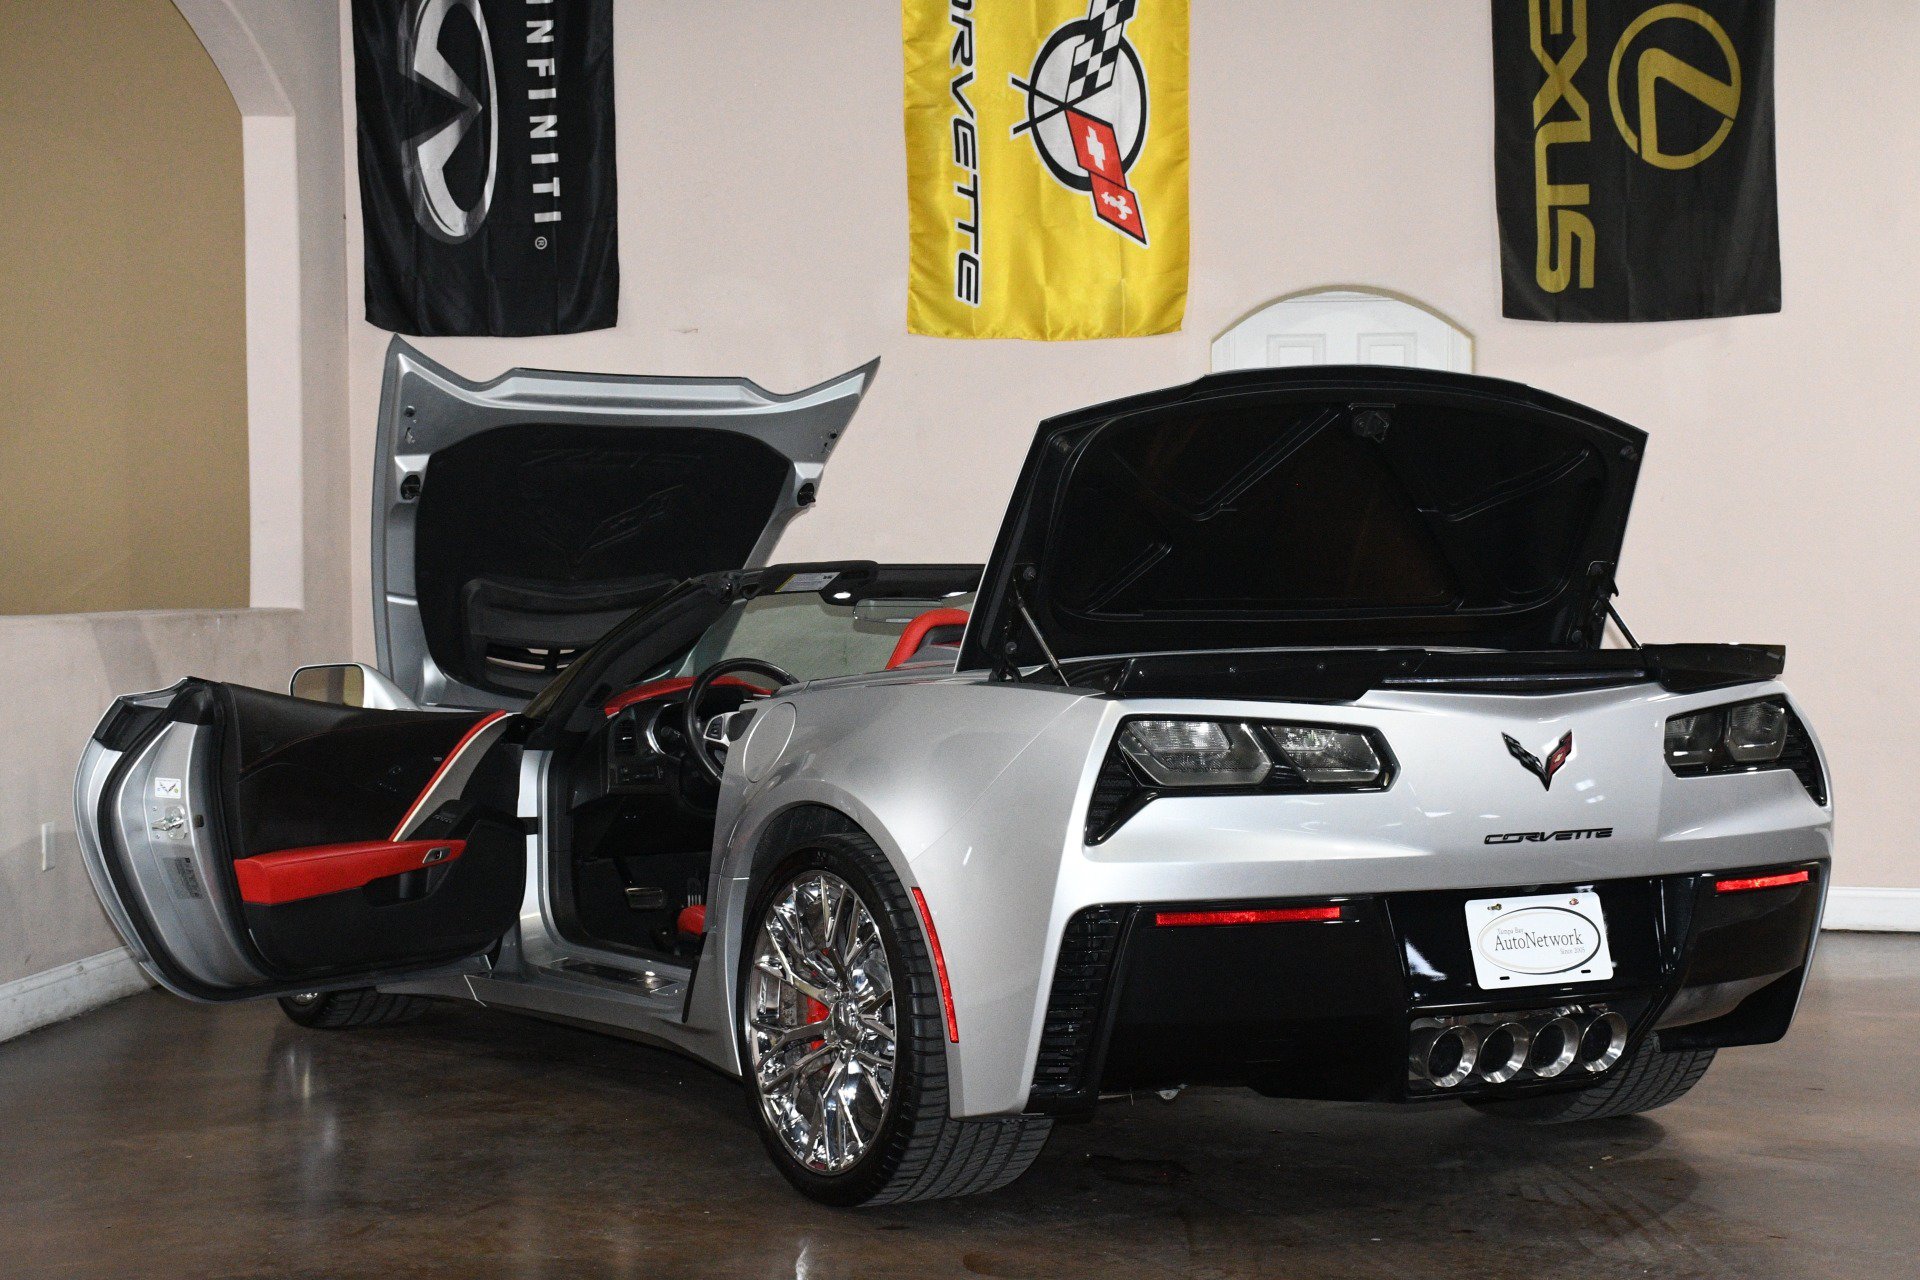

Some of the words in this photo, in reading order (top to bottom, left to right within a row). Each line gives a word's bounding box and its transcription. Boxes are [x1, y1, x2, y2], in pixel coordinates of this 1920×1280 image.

[950, 0, 980, 304] RVETTE
[1484, 827, 1614, 844] CORVETTE
[1495, 928, 1584, 951] AutoNetwork
